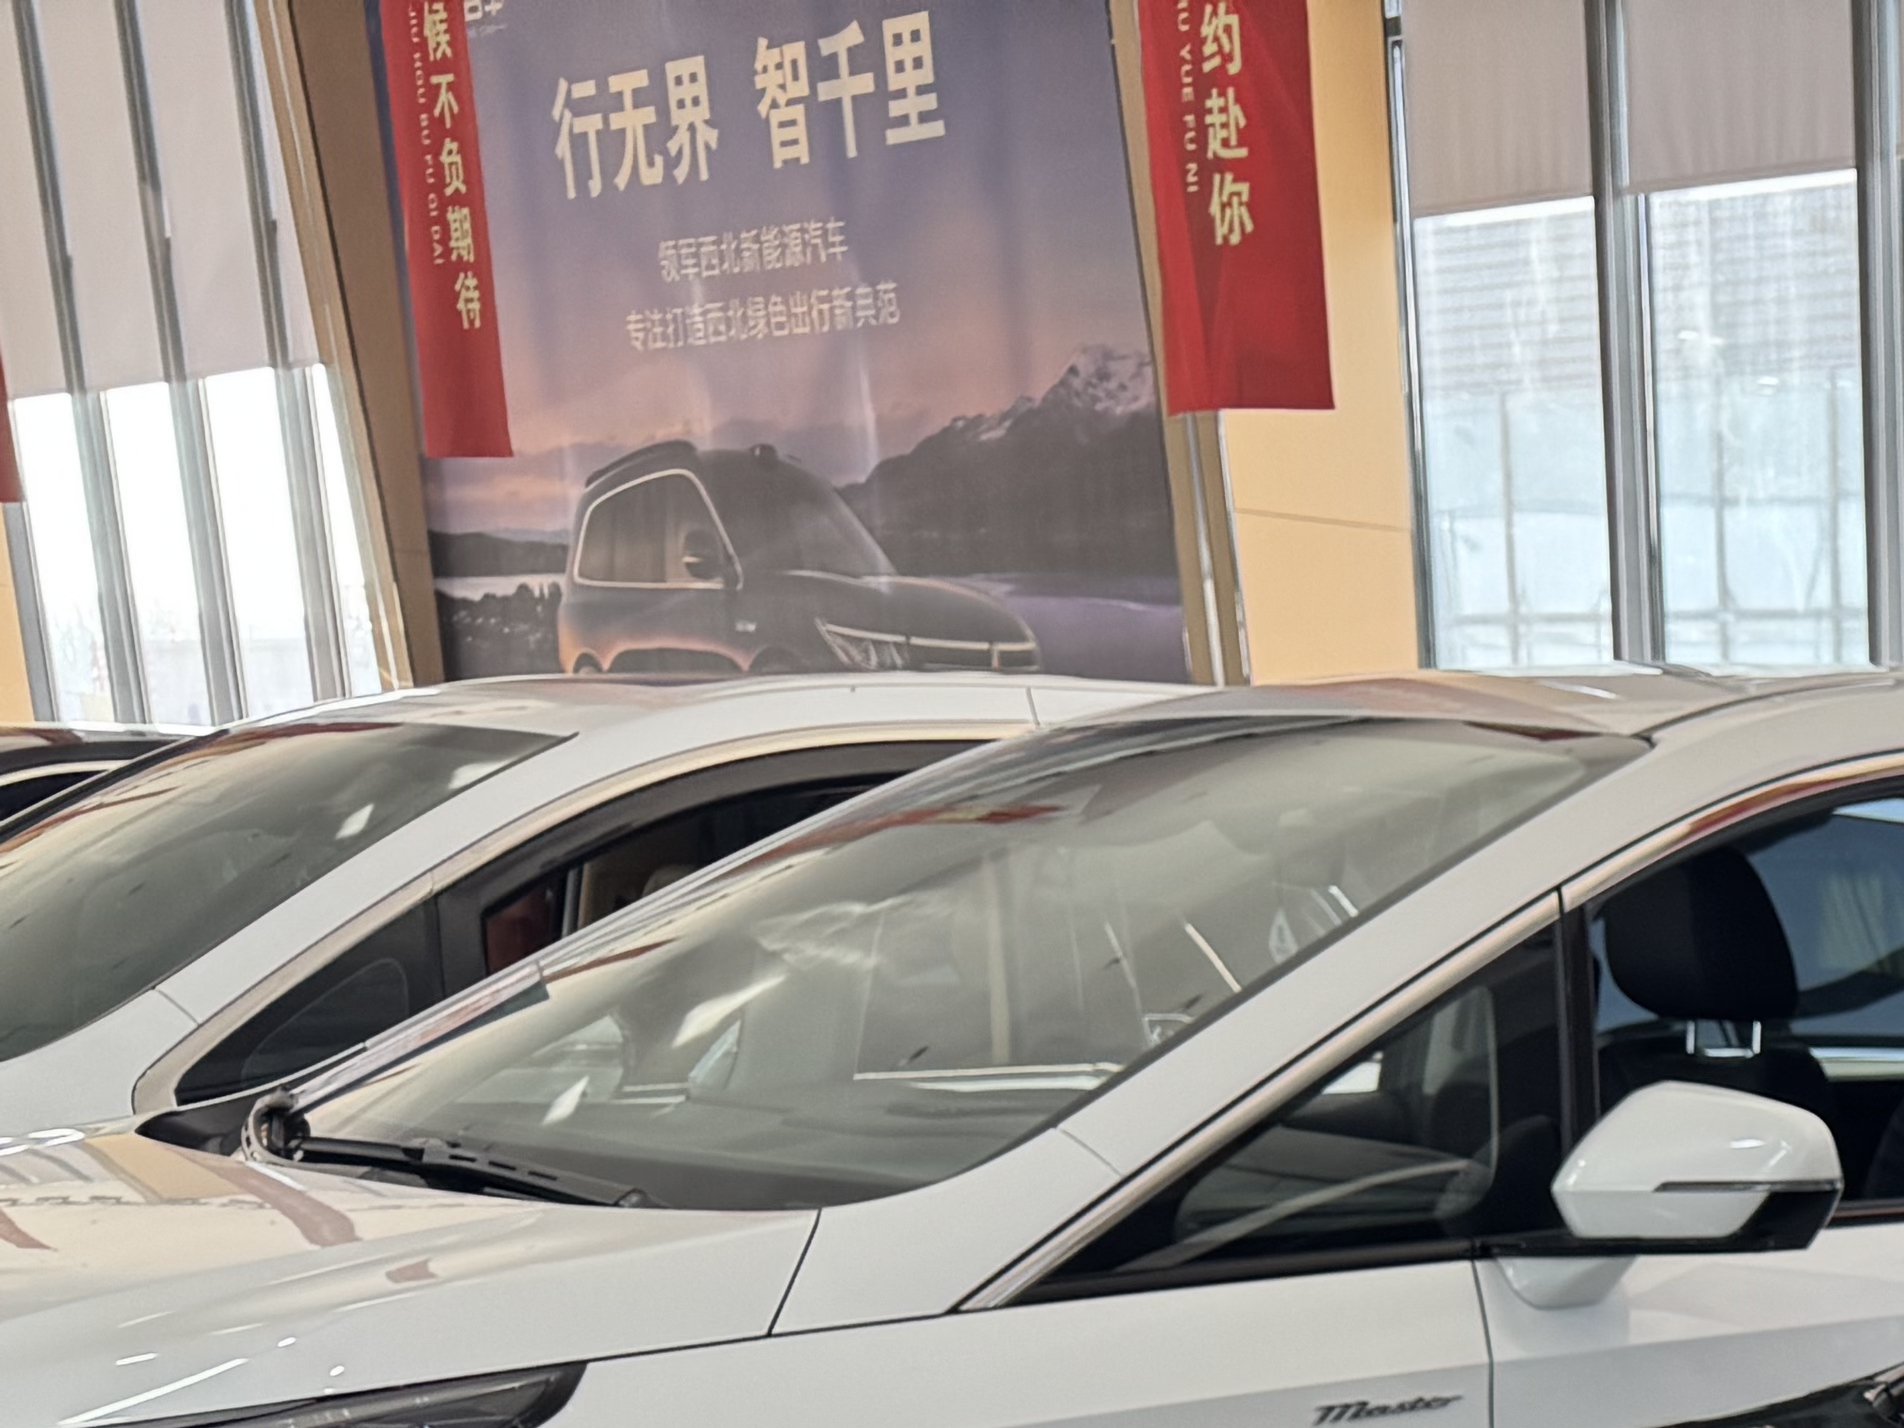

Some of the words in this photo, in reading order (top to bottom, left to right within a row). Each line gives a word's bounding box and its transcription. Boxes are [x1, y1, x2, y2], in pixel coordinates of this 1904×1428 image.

[1179, 43, 1195, 103] YUE
[551, 55, 719, 200] 行无界
[753, 10, 946, 169] 智千里
[1182, 114, 1197, 151] FU
[1200, 2, 1255, 246] 约赴你
[423, 1, 481, 330] 候不负期待
[1185, 162, 1199, 193] NI
[431, 225, 445, 265] DAI
